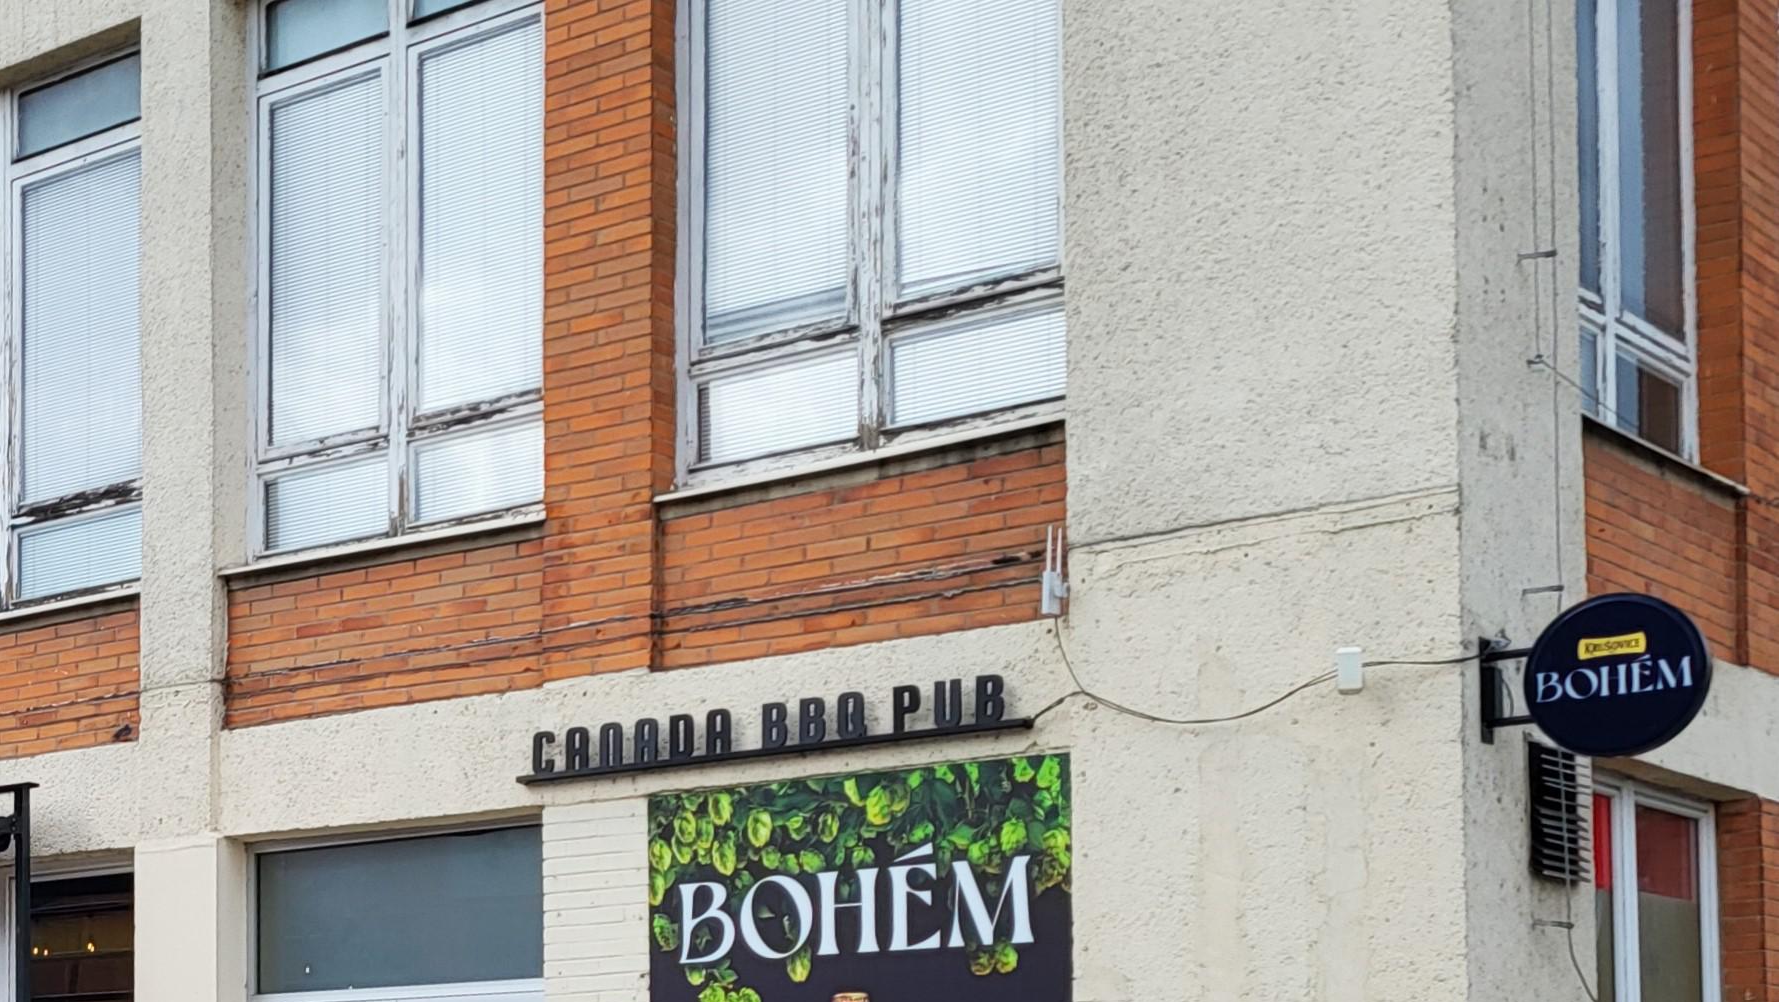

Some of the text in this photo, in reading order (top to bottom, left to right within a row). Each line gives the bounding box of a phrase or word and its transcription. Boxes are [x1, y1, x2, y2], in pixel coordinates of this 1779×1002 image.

[532, 674, 1004, 775] CANADA BBQ PUB
[1536, 653, 1693, 704] BOHÉM
[678, 842, 1035, 964] BOHÉM
